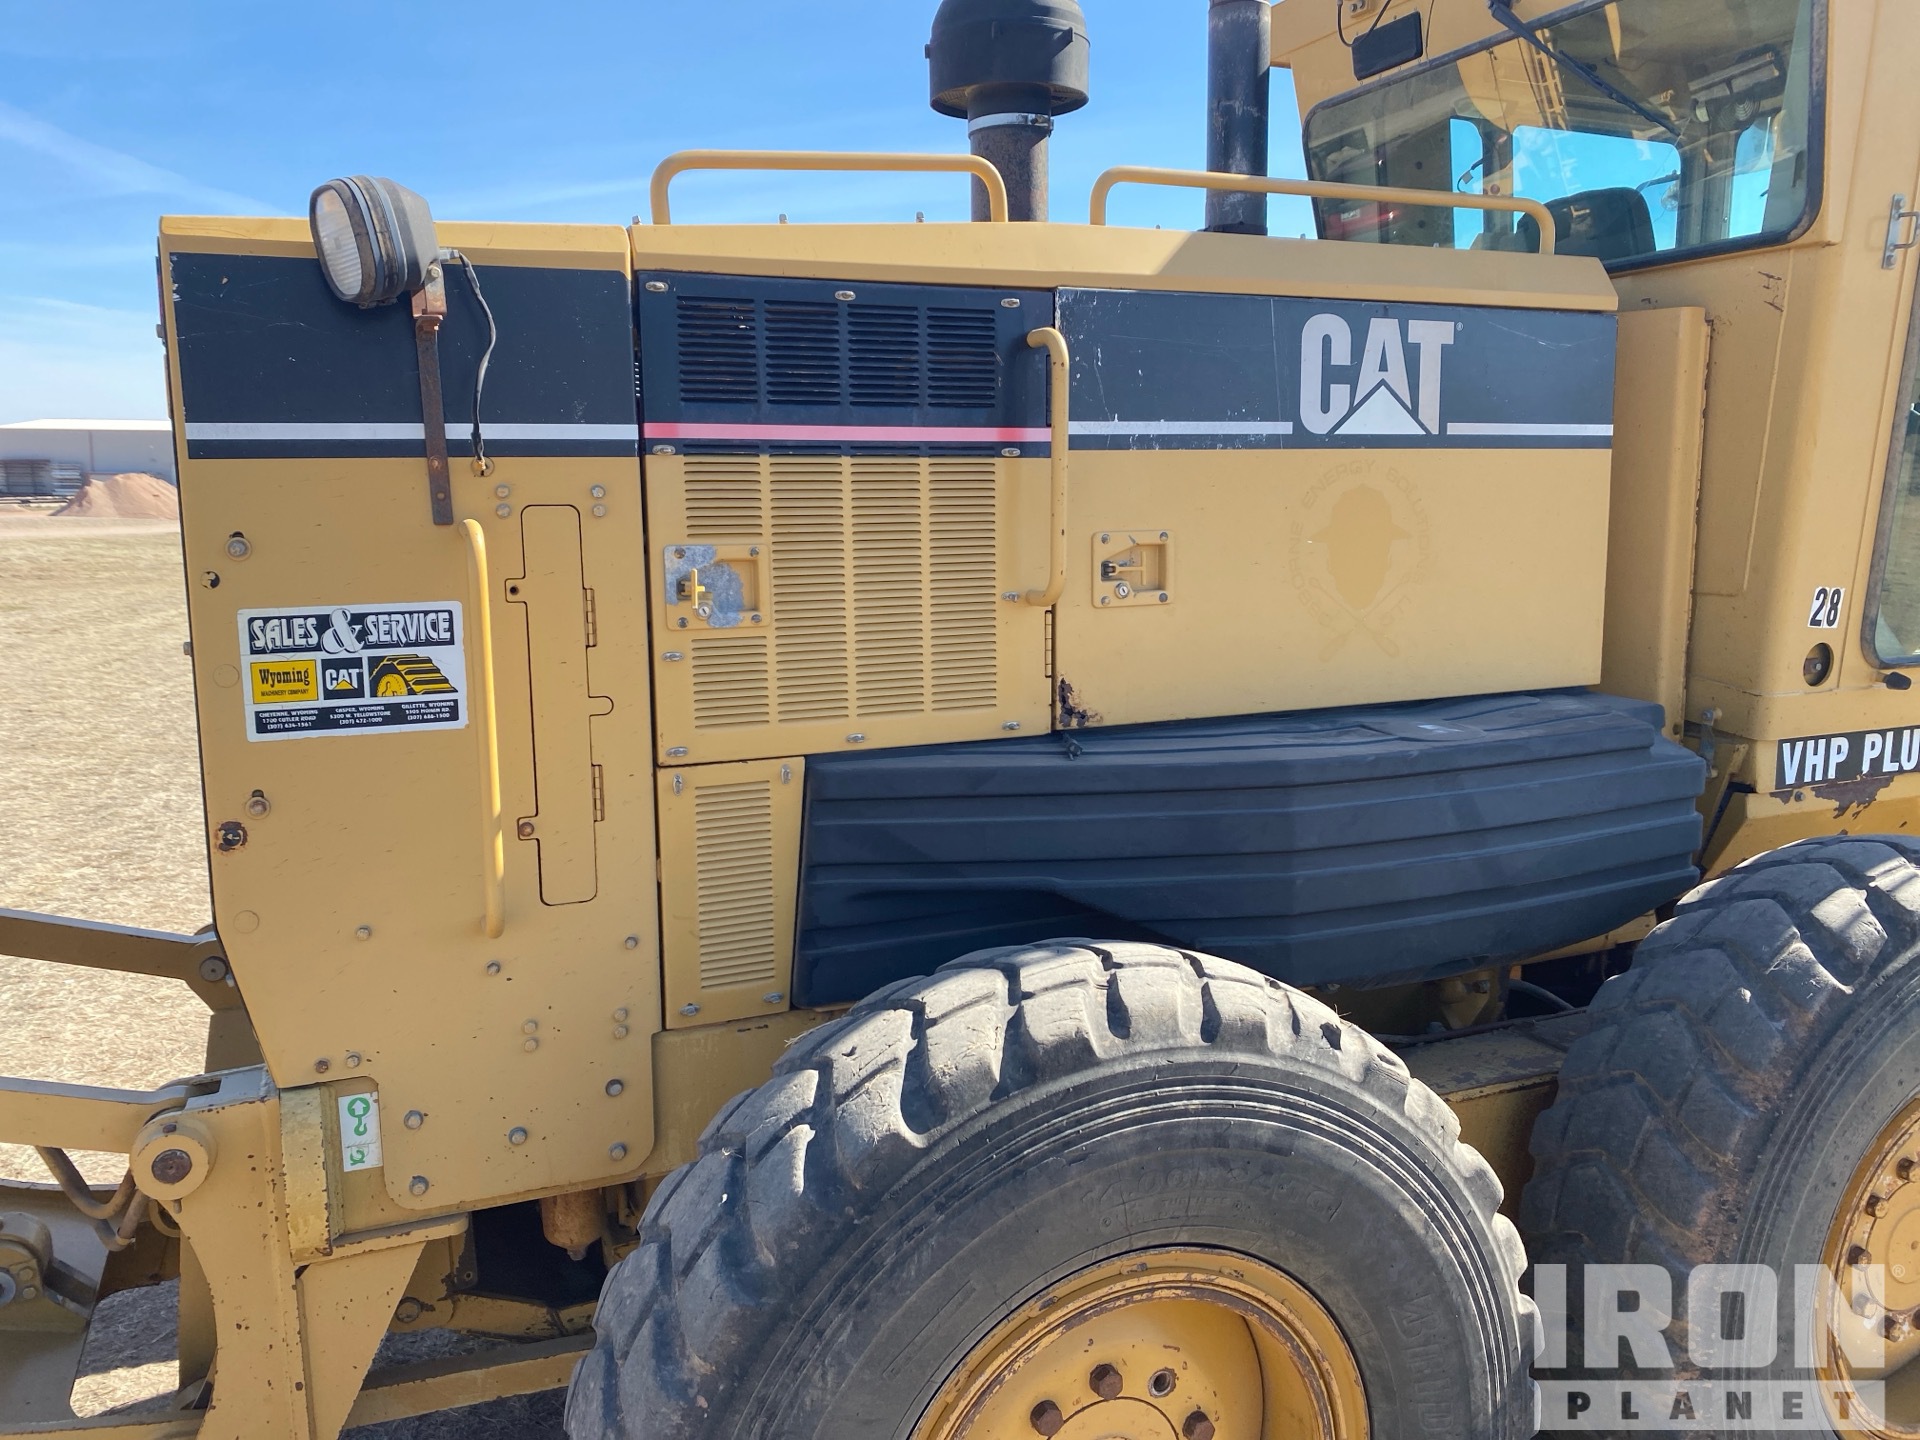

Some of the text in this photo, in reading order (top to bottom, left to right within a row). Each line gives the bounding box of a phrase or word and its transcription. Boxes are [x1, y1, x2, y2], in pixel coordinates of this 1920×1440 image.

[1300, 313, 1455, 435] CAT
[1809, 587, 1842, 627] 28
[251, 608, 452, 654] SALES & SERVICE
[258, 667, 310, 688] Wyoming
[261, 688, 309, 697] MACHINERY COMPANY
[325, 668, 361, 691] CAT
[1782, 736, 1850, 786] VHP
